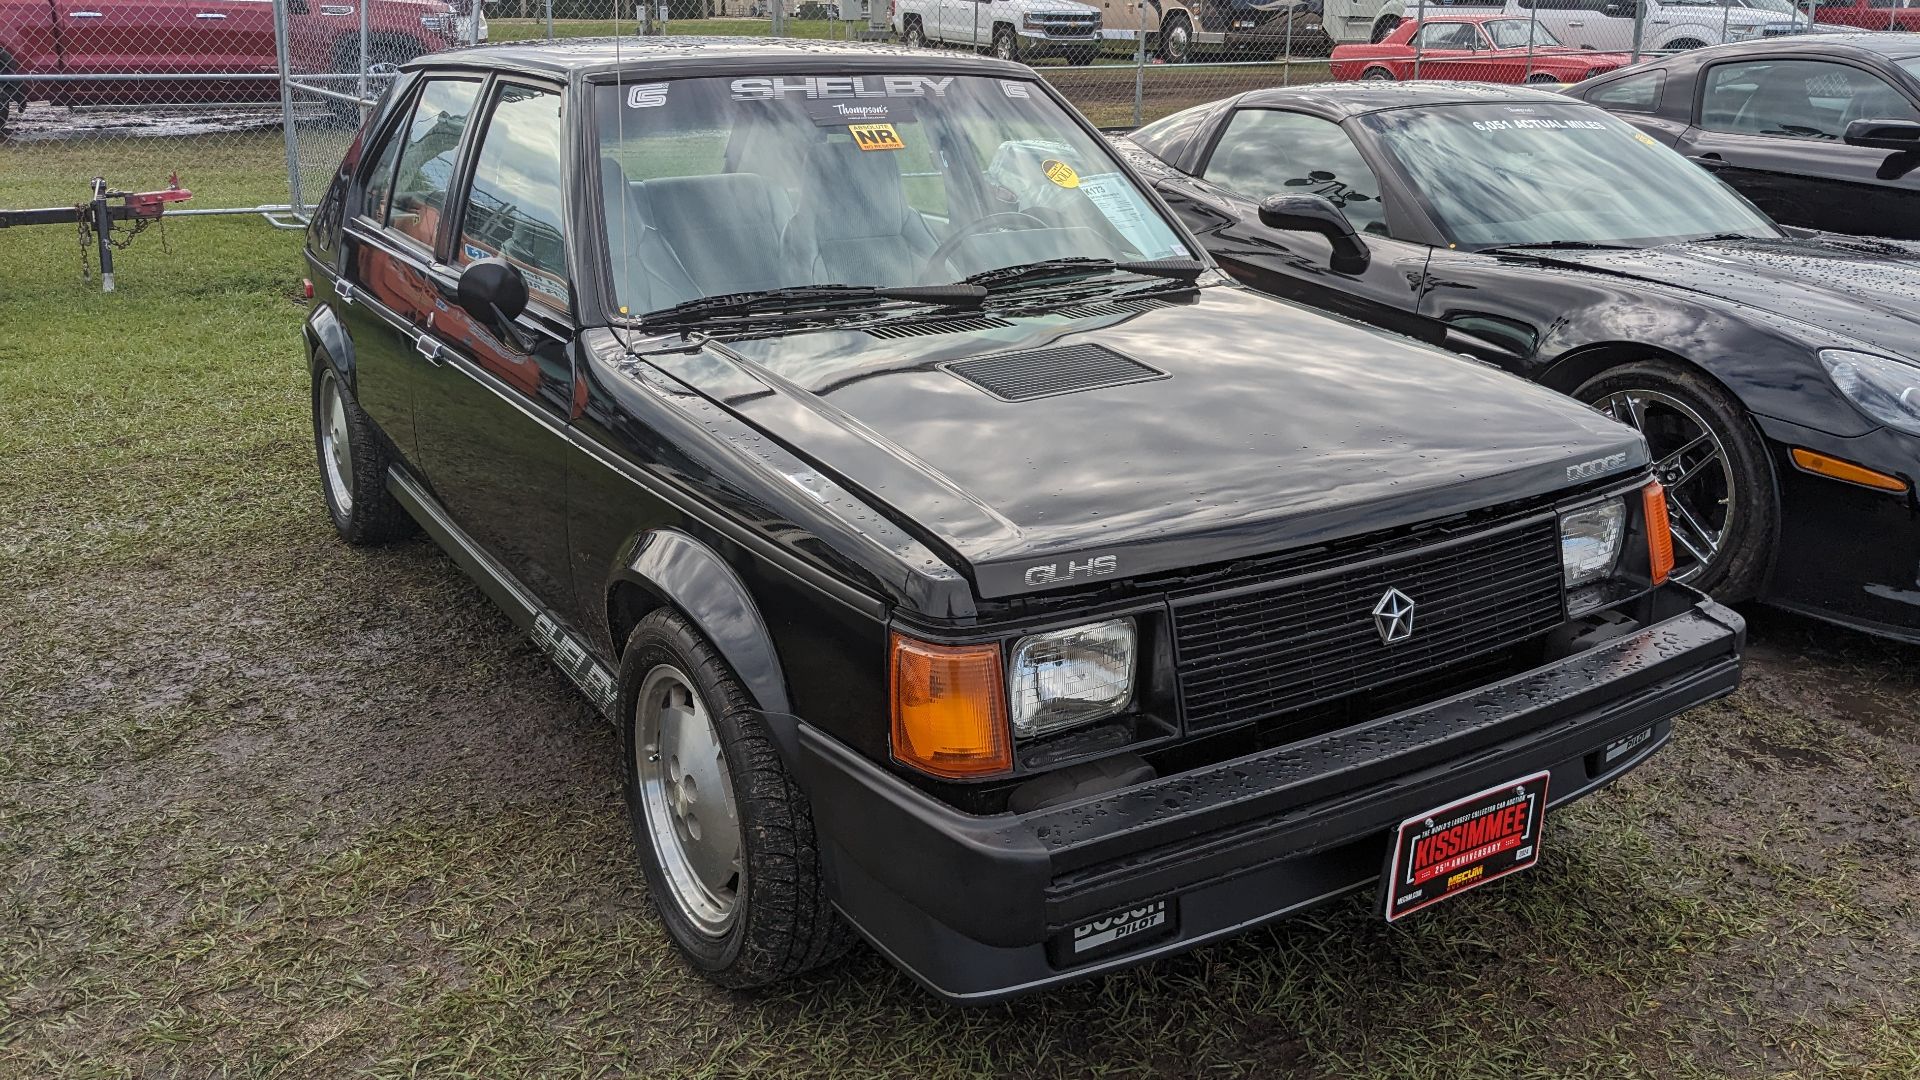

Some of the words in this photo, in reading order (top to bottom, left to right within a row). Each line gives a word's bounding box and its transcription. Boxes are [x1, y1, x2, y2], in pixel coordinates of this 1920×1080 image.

[730, 76, 955, 101] SHELBY
[832, 103, 889, 117] Thompson's
[854, 129, 898, 144] NR
[1472, 120, 1512, 133] 6,051
[1515, 119, 1568, 129] ACTUAL
[1565, 120, 1606, 130] MILES
[1054, 167, 1073, 186] SOLD
[1083, 185, 1106, 196] K173
[1566, 452, 1627, 482] DODGE
[1025, 554, 1117, 586] GLHS
[1415, 802, 1528, 869] KISSIMMEE
[1421, 829, 1431, 839] THE
[1451, 842, 1501, 868] ANNIVERSARY
[1447, 864, 1484, 887] MECUM
[1115, 914, 1158, 938] PILOT
